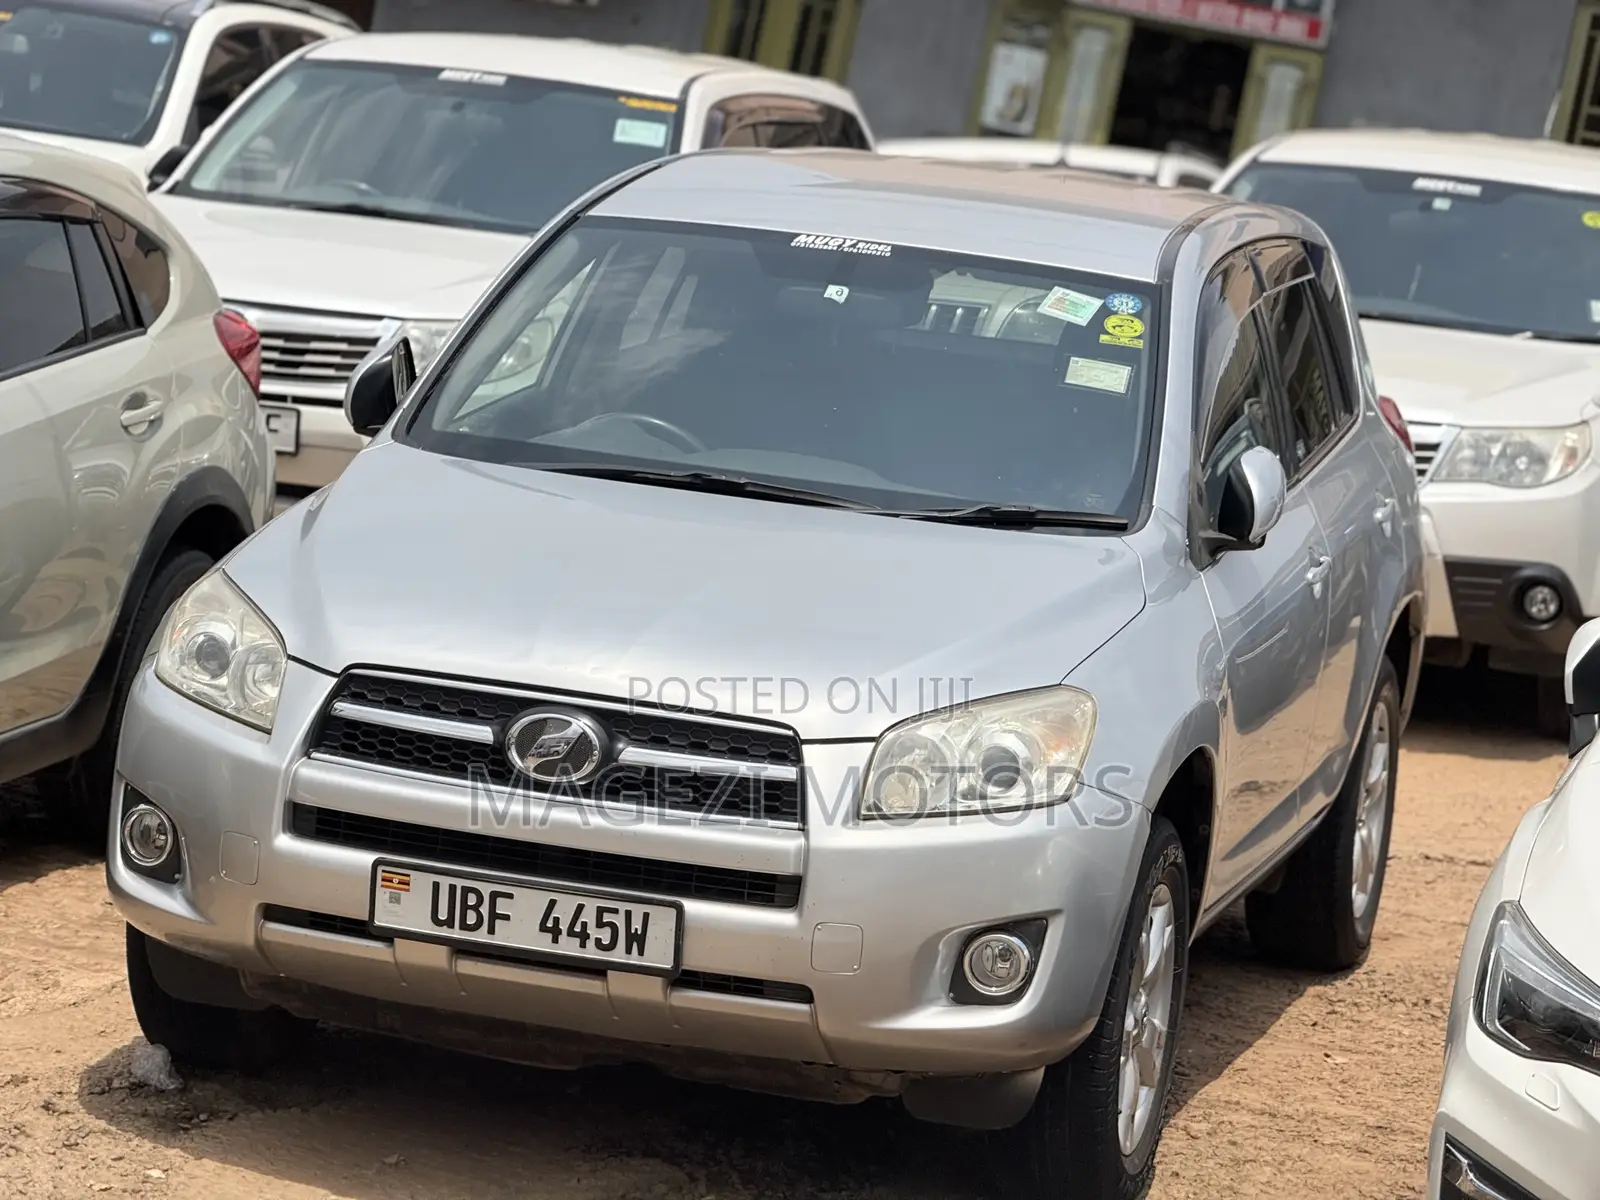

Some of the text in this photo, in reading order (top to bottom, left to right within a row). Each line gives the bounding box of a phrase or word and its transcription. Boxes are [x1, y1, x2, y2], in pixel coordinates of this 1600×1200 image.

[793, 235, 892, 252] MUGY RIDES
[430, 880, 651, 957] UBF 445W
